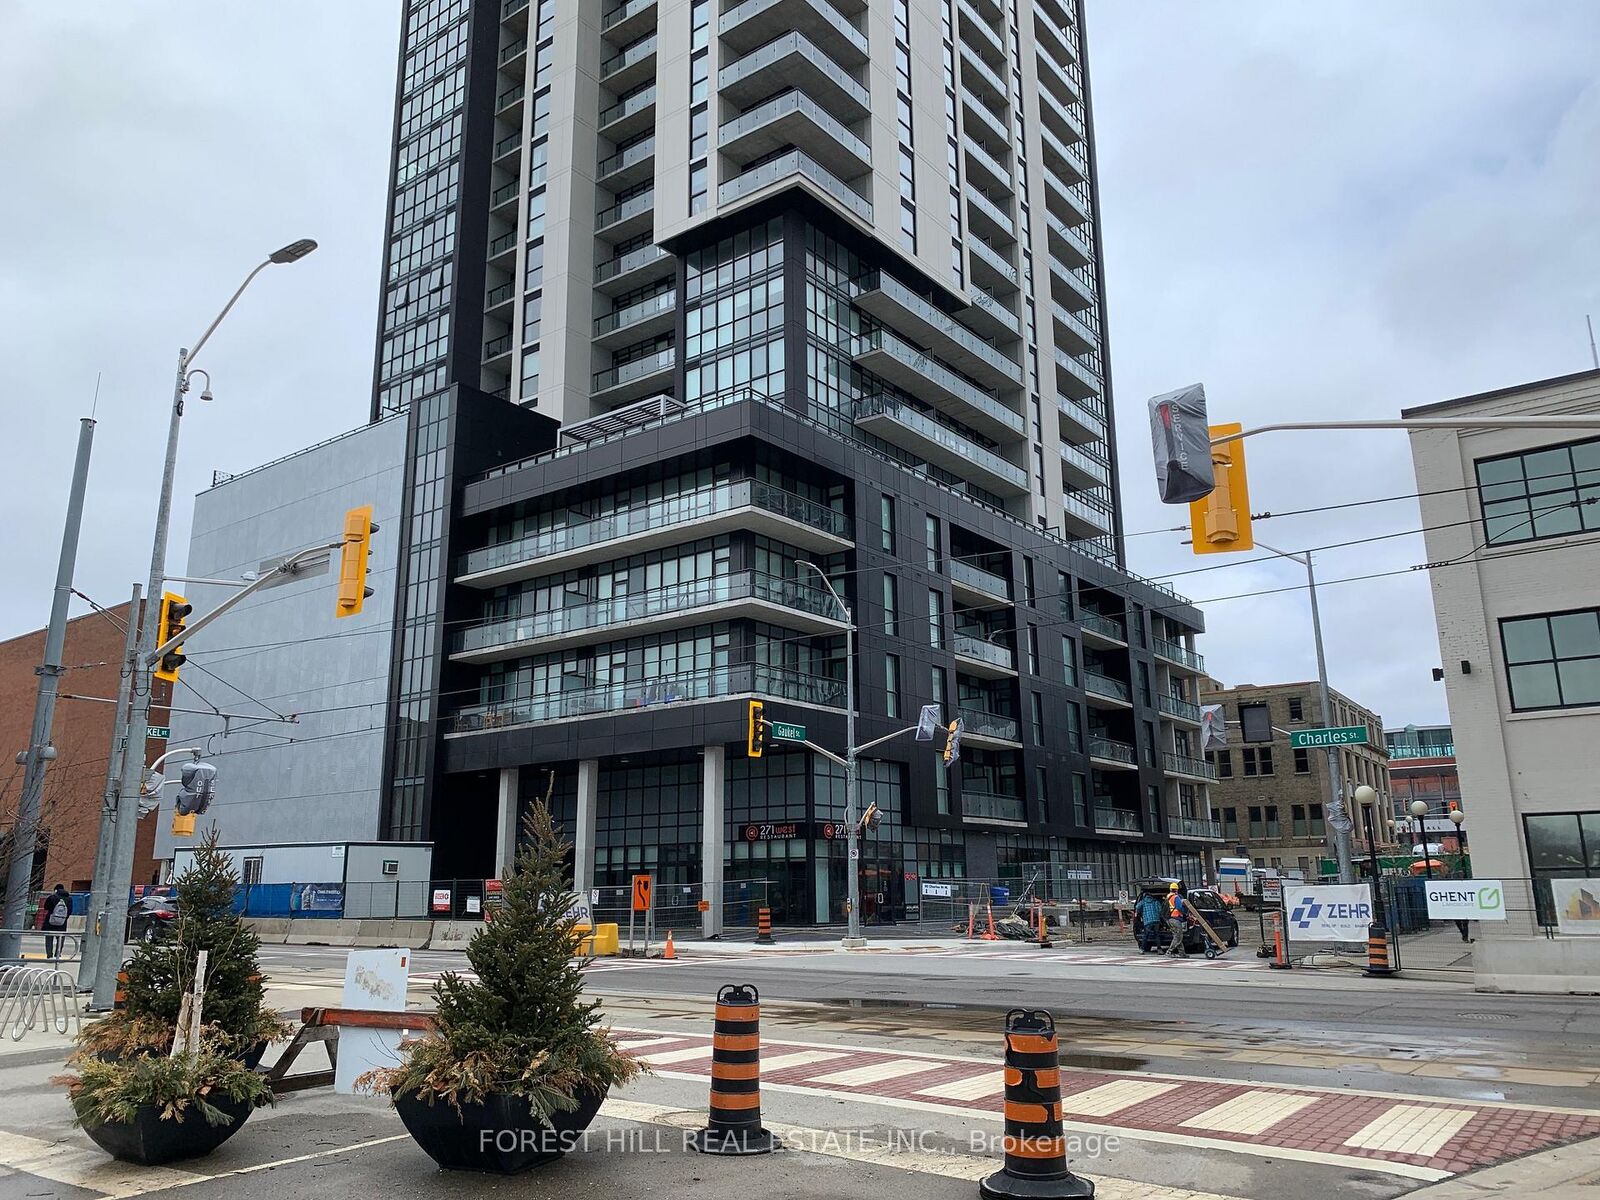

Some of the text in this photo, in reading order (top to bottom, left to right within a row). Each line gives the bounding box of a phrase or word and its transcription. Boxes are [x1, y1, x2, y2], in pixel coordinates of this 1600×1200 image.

[1171, 404, 1189, 471] SERVICE
[147, 727, 162, 737] KEL
[777, 726, 795, 738] Gaukel
[1298, 731, 1348, 745] Charles
[1429, 891, 1476, 902] GHENT
[562, 906, 589, 919] EHR
[1327, 903, 1371, 919] ZEHR
